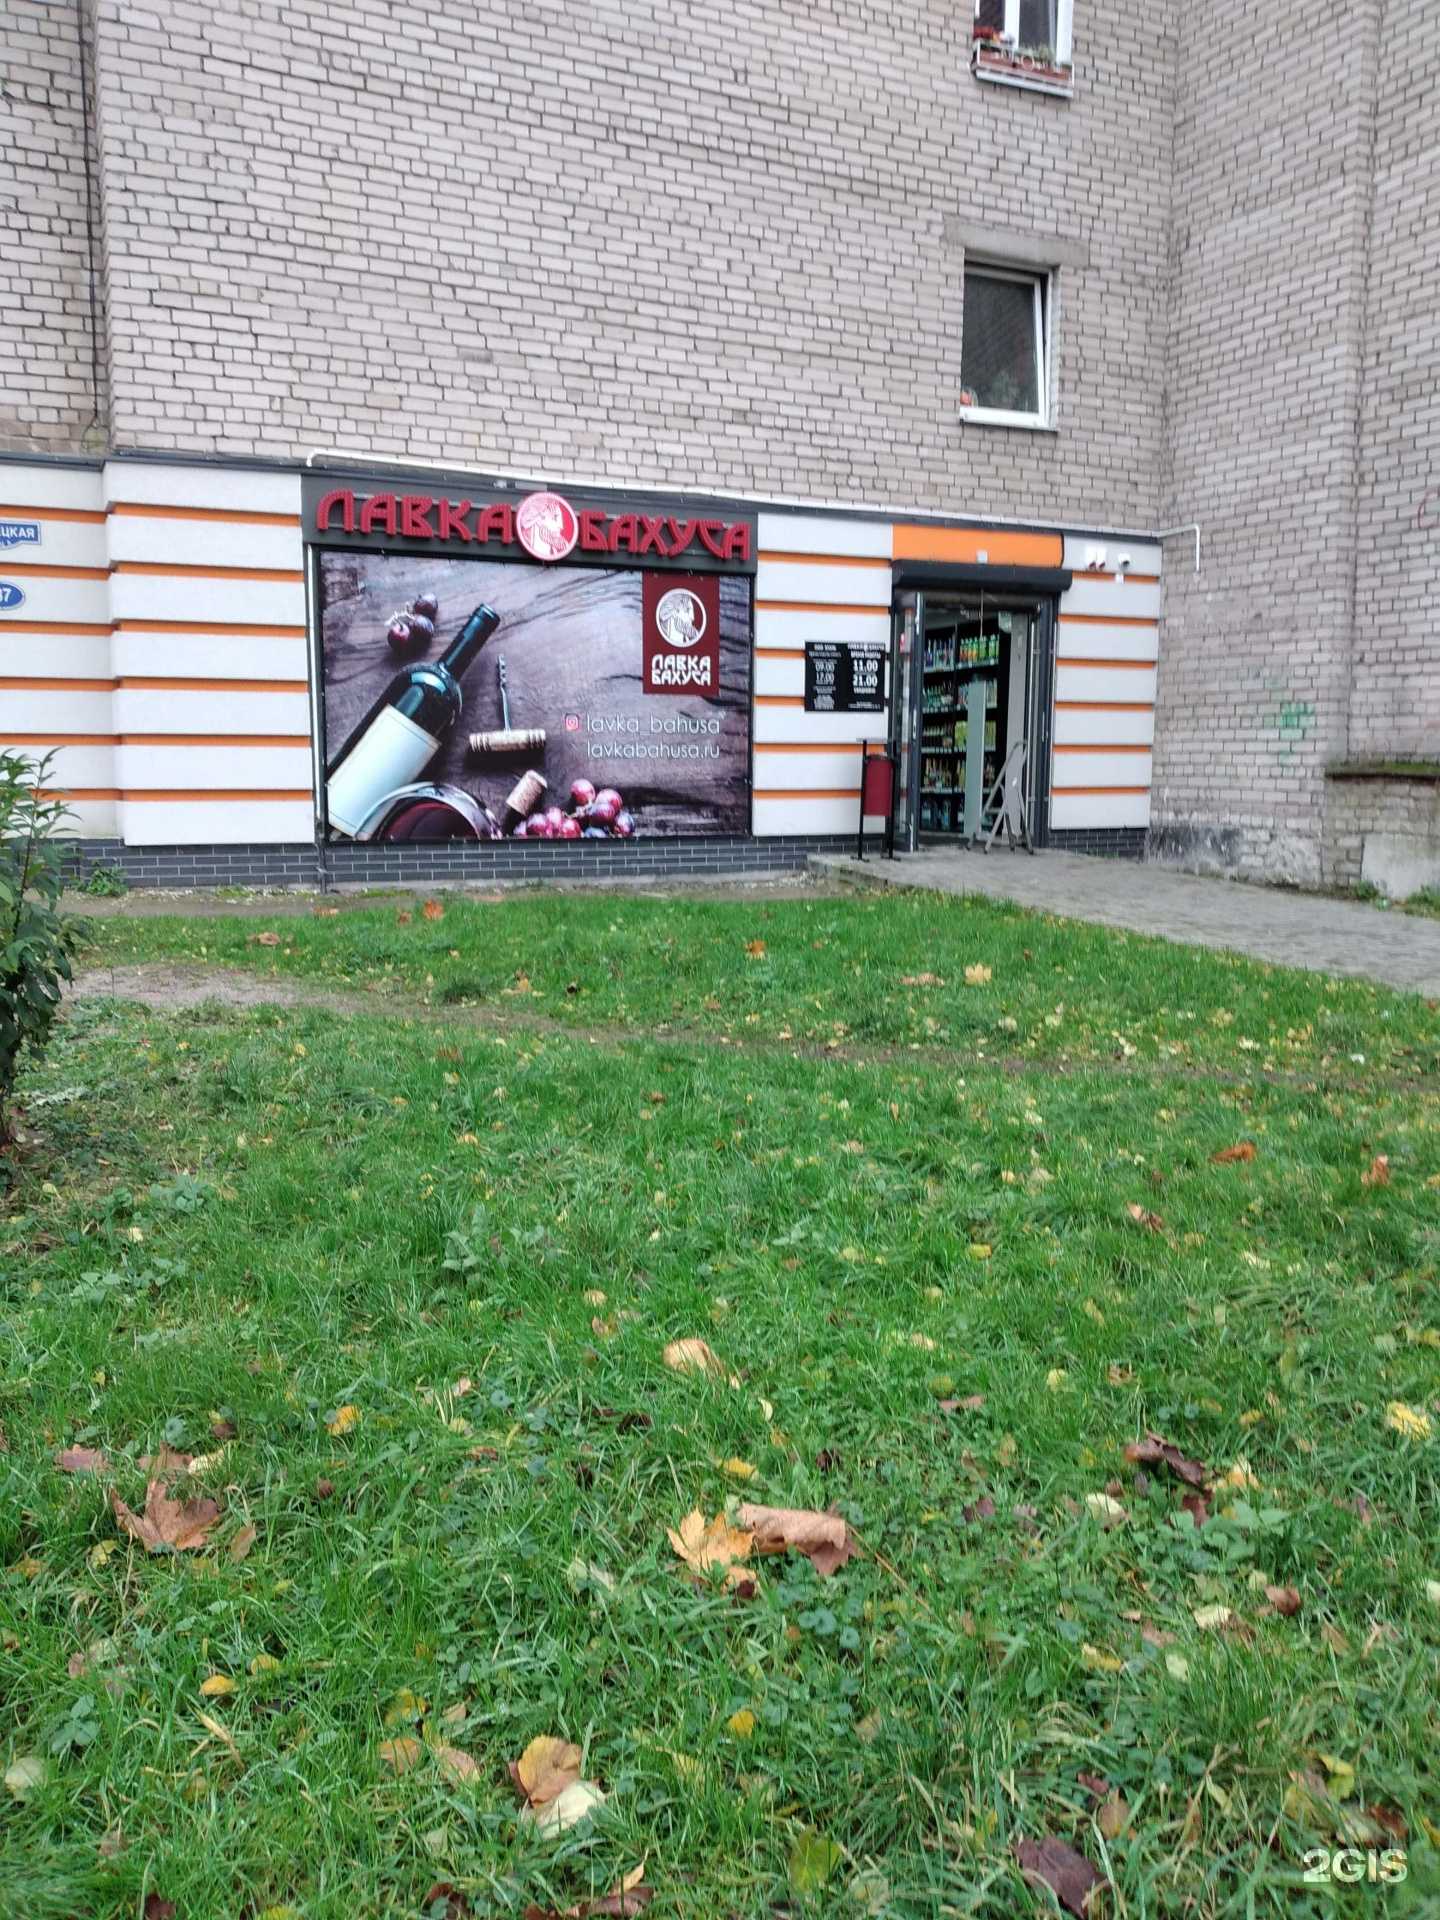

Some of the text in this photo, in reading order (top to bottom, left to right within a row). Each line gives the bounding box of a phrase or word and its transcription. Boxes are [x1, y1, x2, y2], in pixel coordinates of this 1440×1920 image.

[0, 525, 35, 540] ЦКАЯ
[316, 488, 751, 561] ЛАВКА БАХУСА
[652, 654, 711, 671] ЛАВКА
[652, 669, 711, 687] БАХУСА
[586, 713, 720, 735] lavka_bahusa
[586, 741, 720, 759] lavkabahusa.ru
